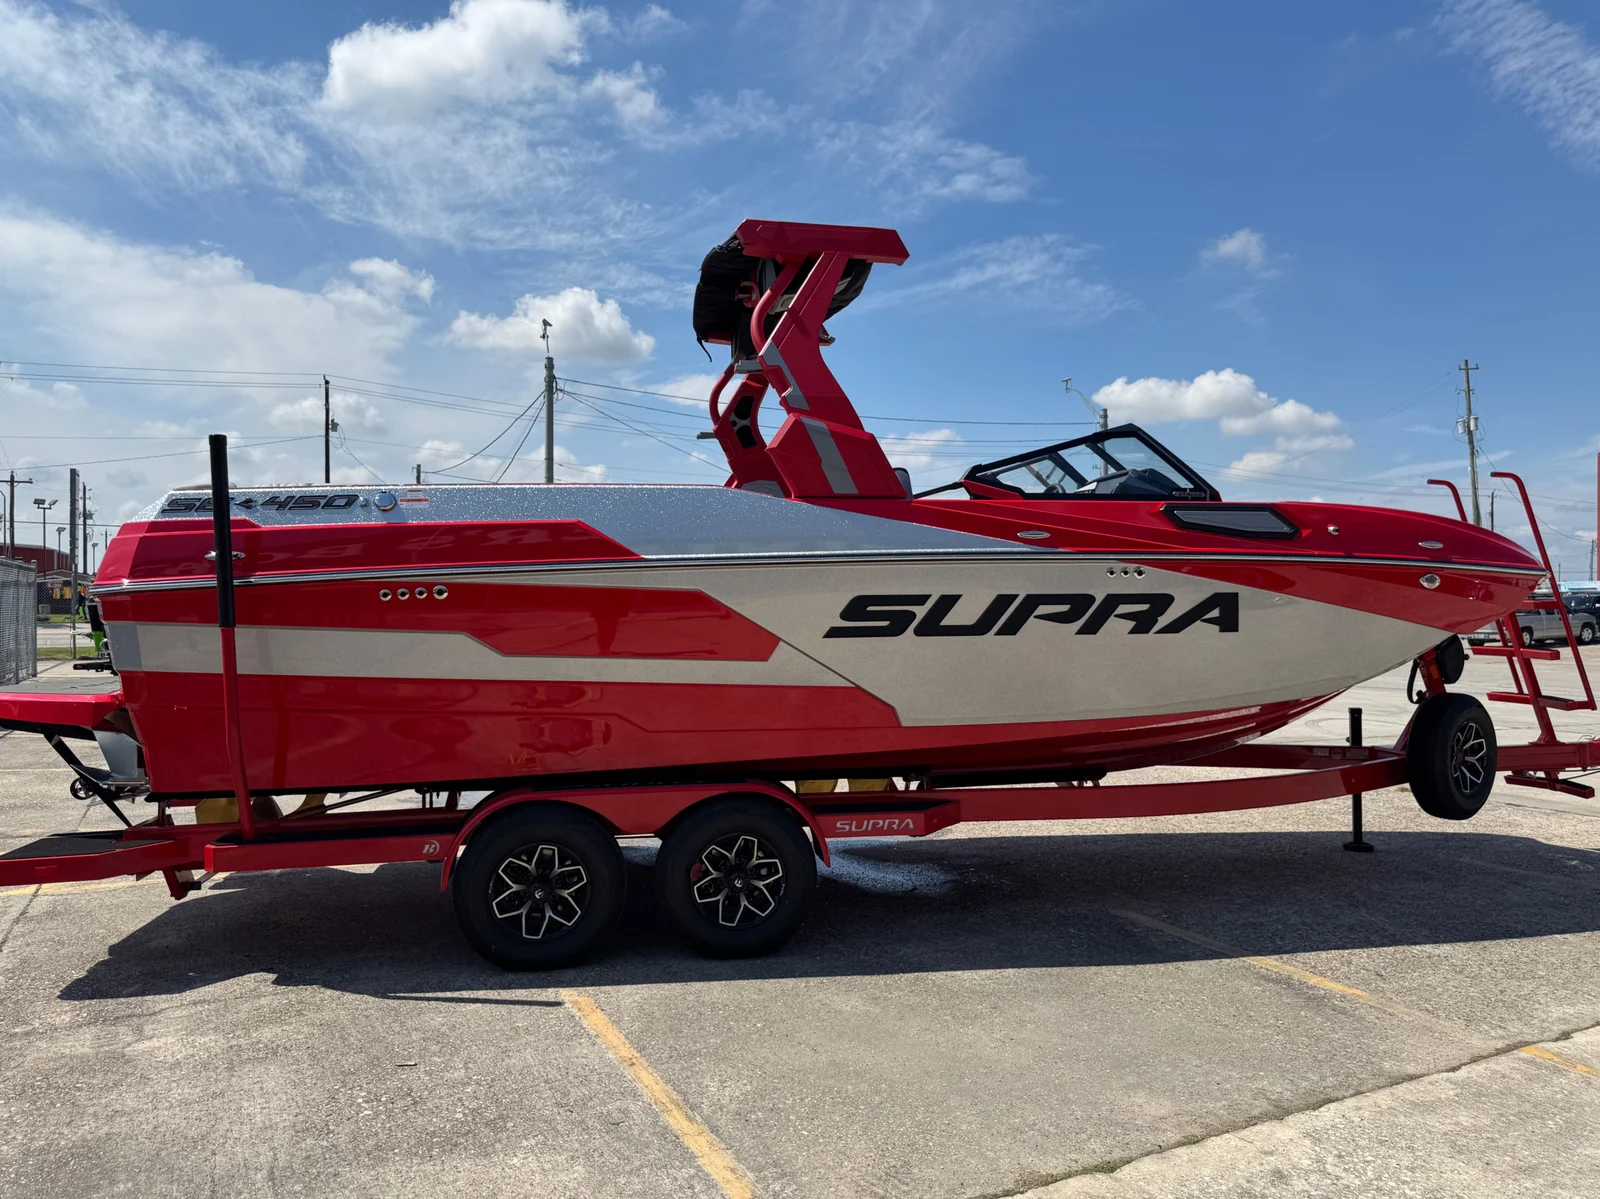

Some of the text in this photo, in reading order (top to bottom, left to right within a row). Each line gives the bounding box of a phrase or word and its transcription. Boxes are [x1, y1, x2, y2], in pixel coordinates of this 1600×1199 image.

[260, 494, 360, 511] 450
[822, 591, 1240, 639] SUPRA
[835, 818, 915, 833] SUPRA
